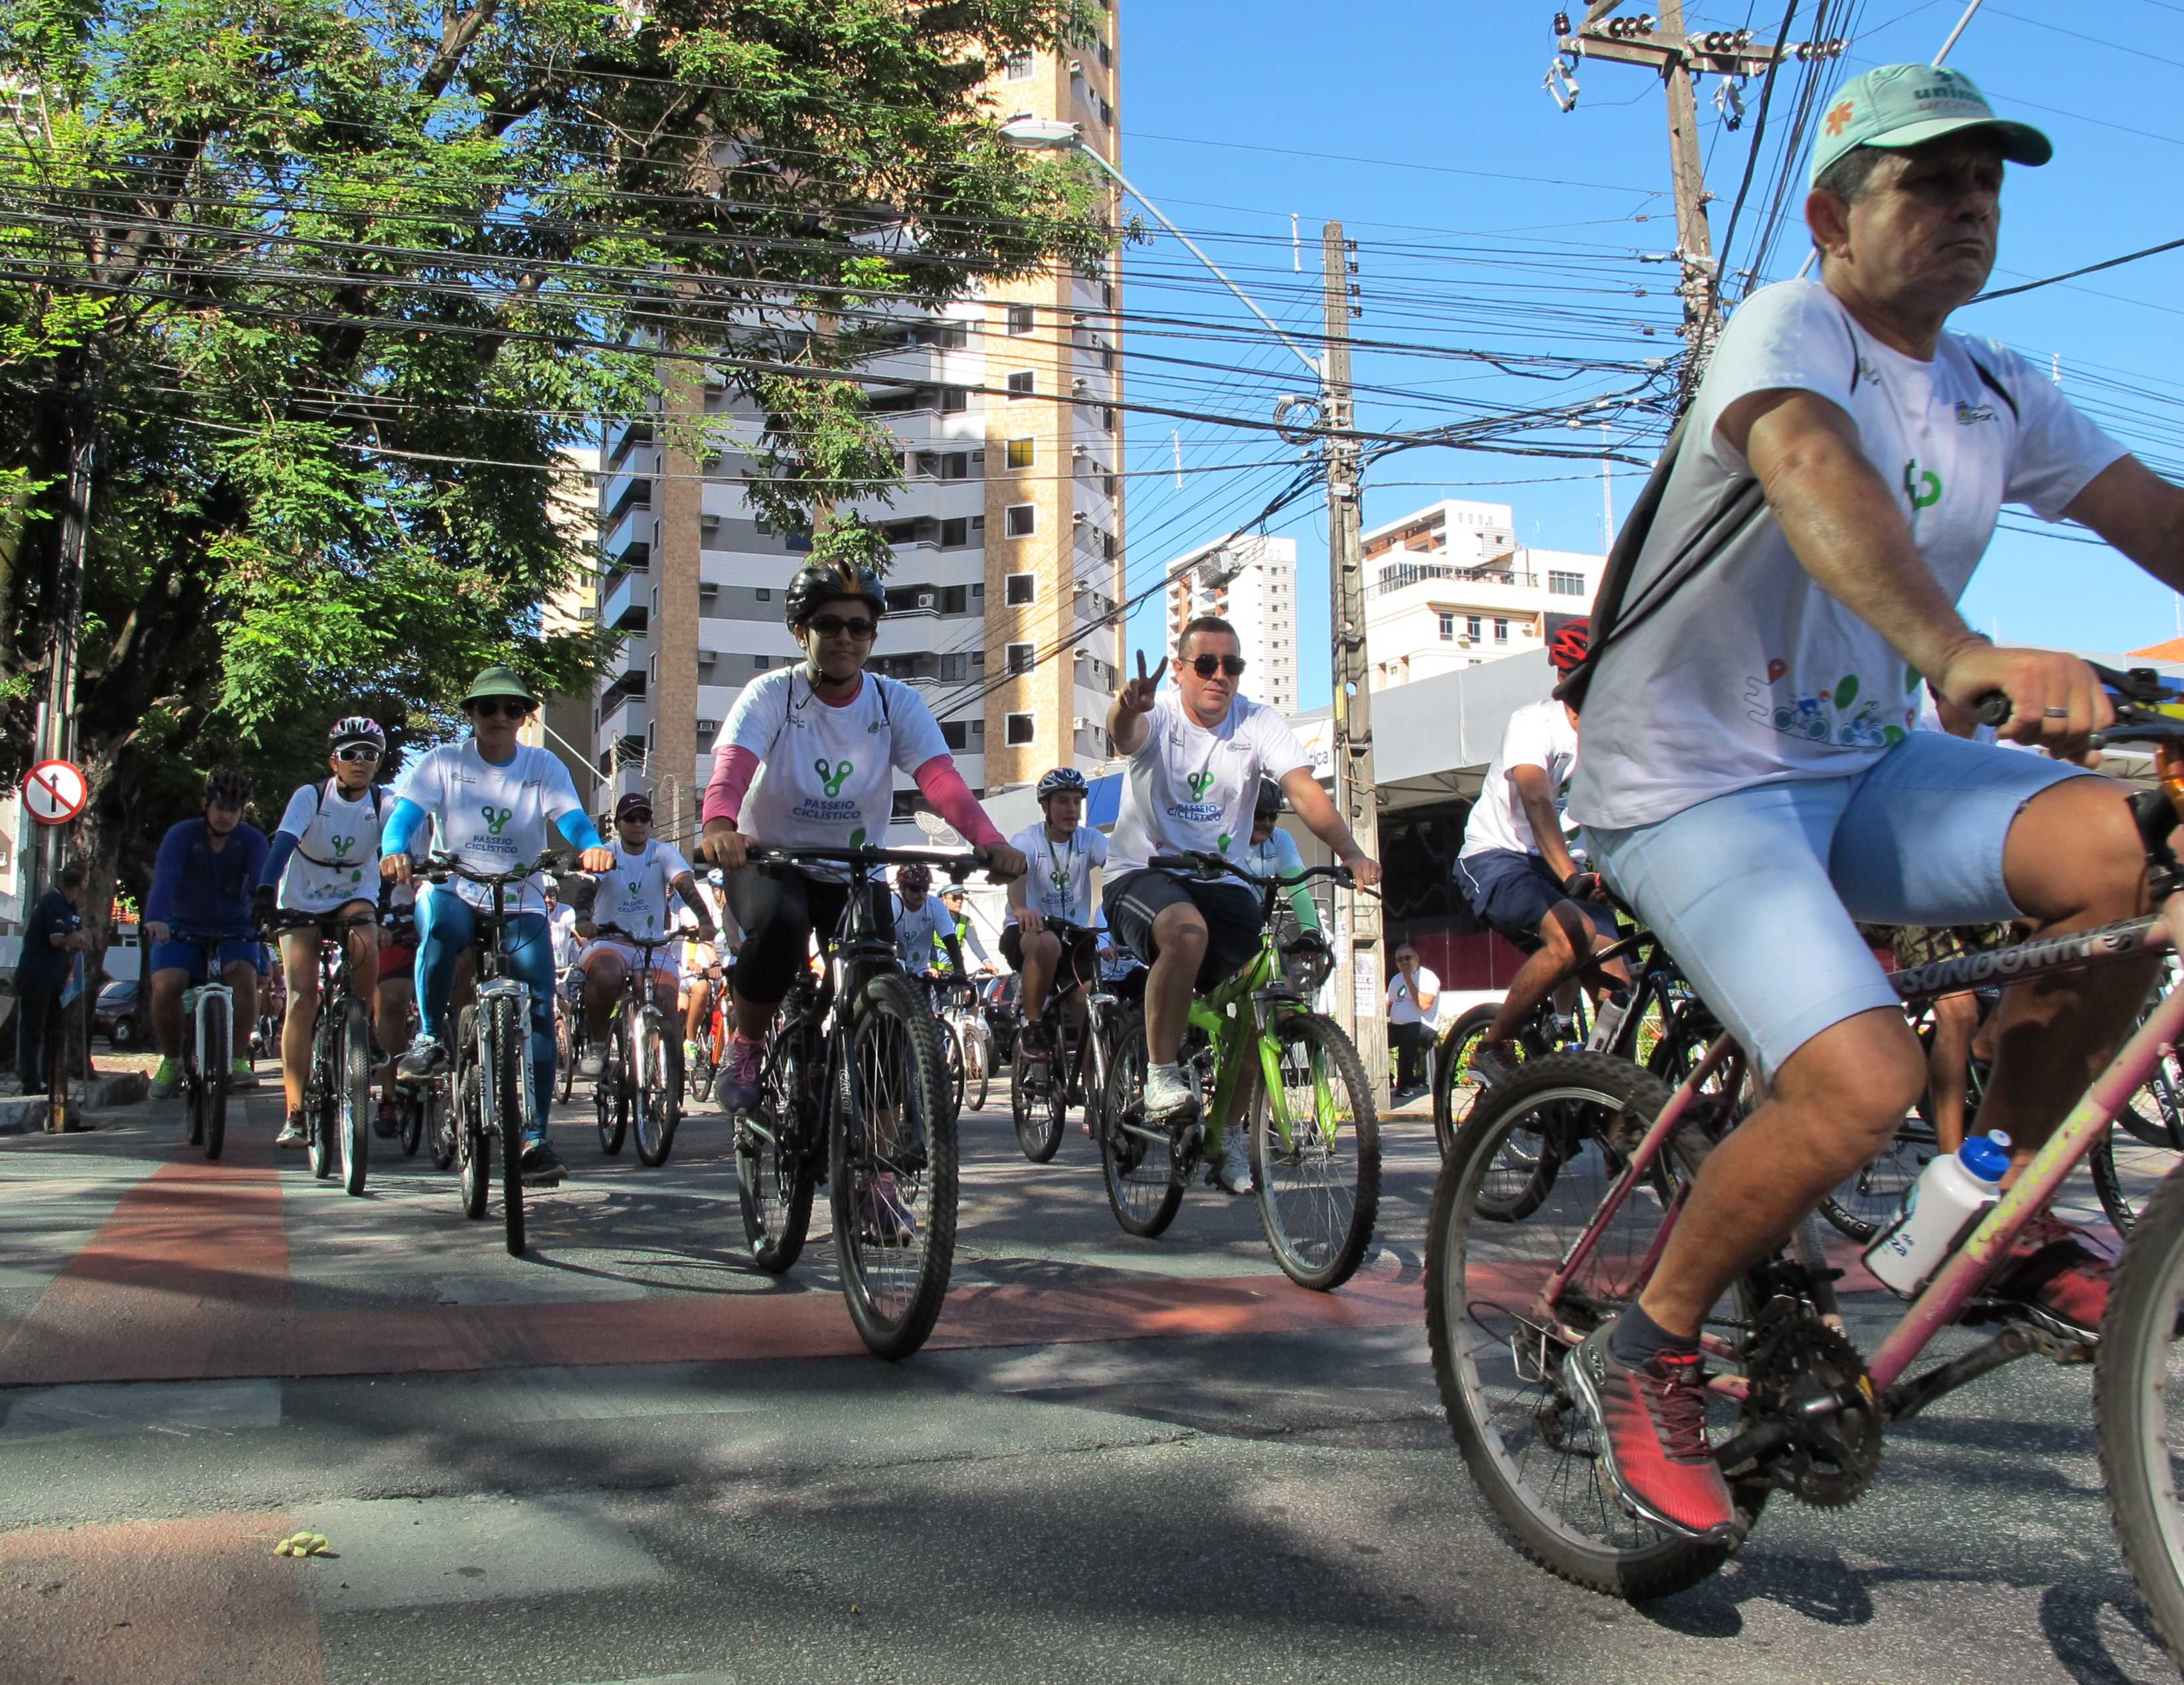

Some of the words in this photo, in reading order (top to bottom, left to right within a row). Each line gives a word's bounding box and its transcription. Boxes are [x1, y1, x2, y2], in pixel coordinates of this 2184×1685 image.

[804, 799, 855, 810] PASSEIO
[1177, 803, 1217, 813] PASSEIO
[792, 807, 861, 820] CICLÍSTICO
[473, 835, 513, 846] PASSEIO
[465, 842, 518, 854] CICLÍSTICO
[1900, 931, 2091, 994] SUNDOWN
[839, 1069, 853, 1115] CALOI
